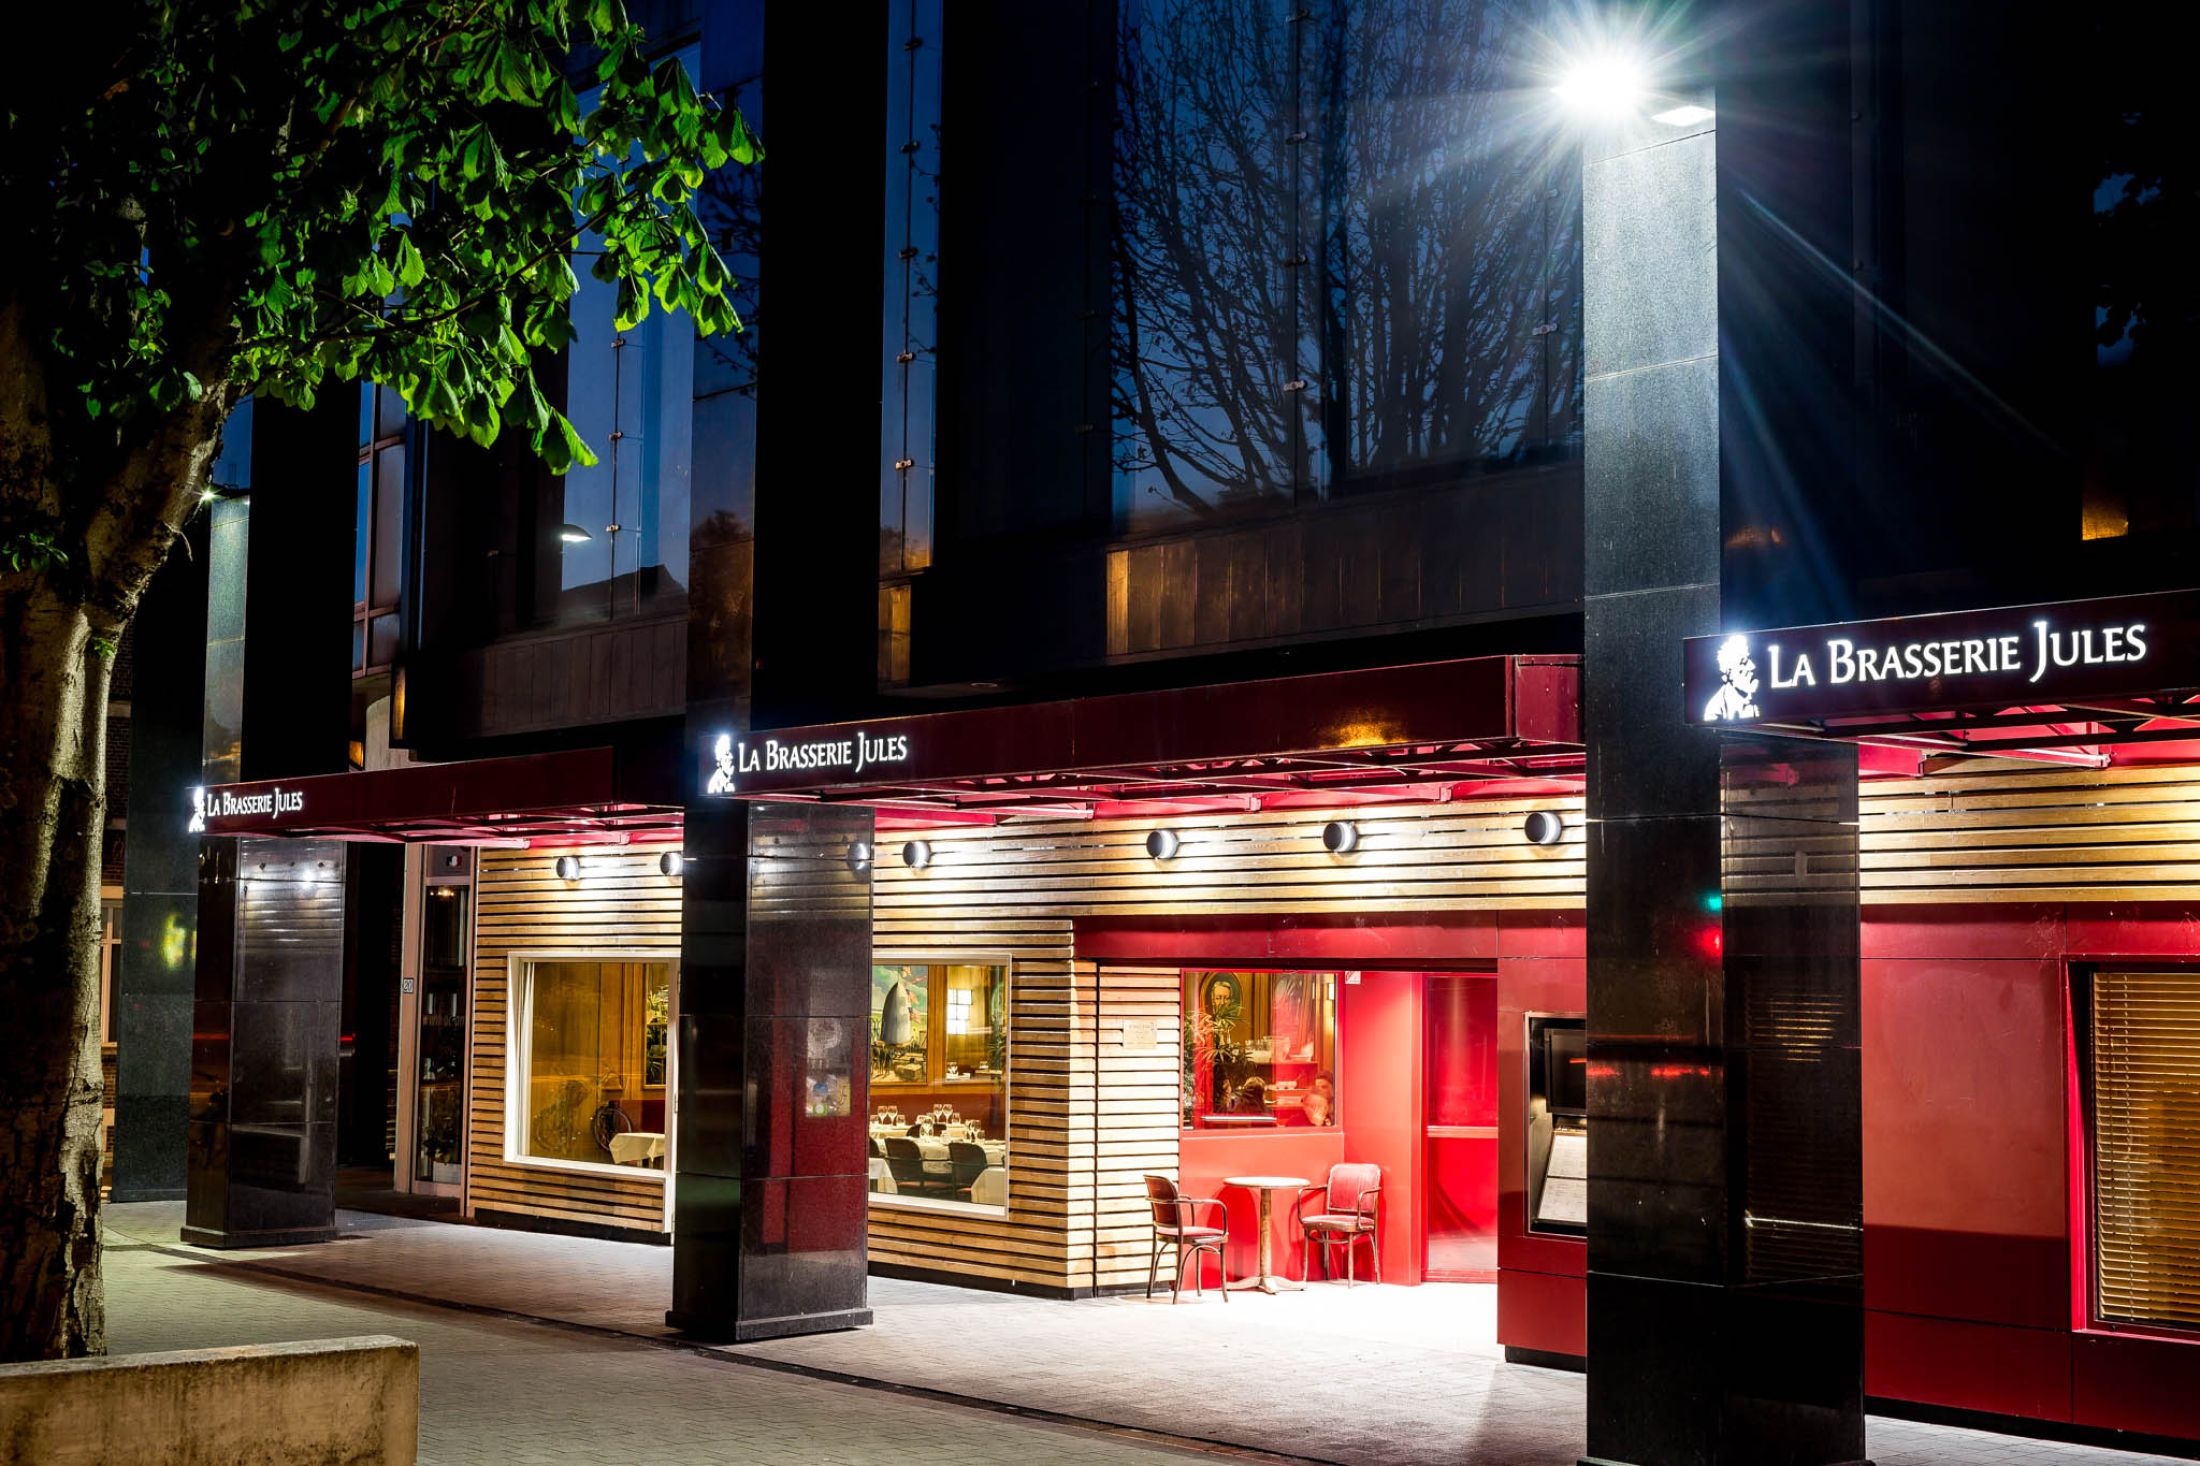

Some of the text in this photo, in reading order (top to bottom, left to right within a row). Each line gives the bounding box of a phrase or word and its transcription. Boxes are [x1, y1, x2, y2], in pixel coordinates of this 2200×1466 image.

[1768, 620, 2148, 689] LA BRASSERIE JULES
[738, 731, 908, 773] LA BRASSERIE JULES
[207, 787, 303, 819] LA BRASSERIE JULES
